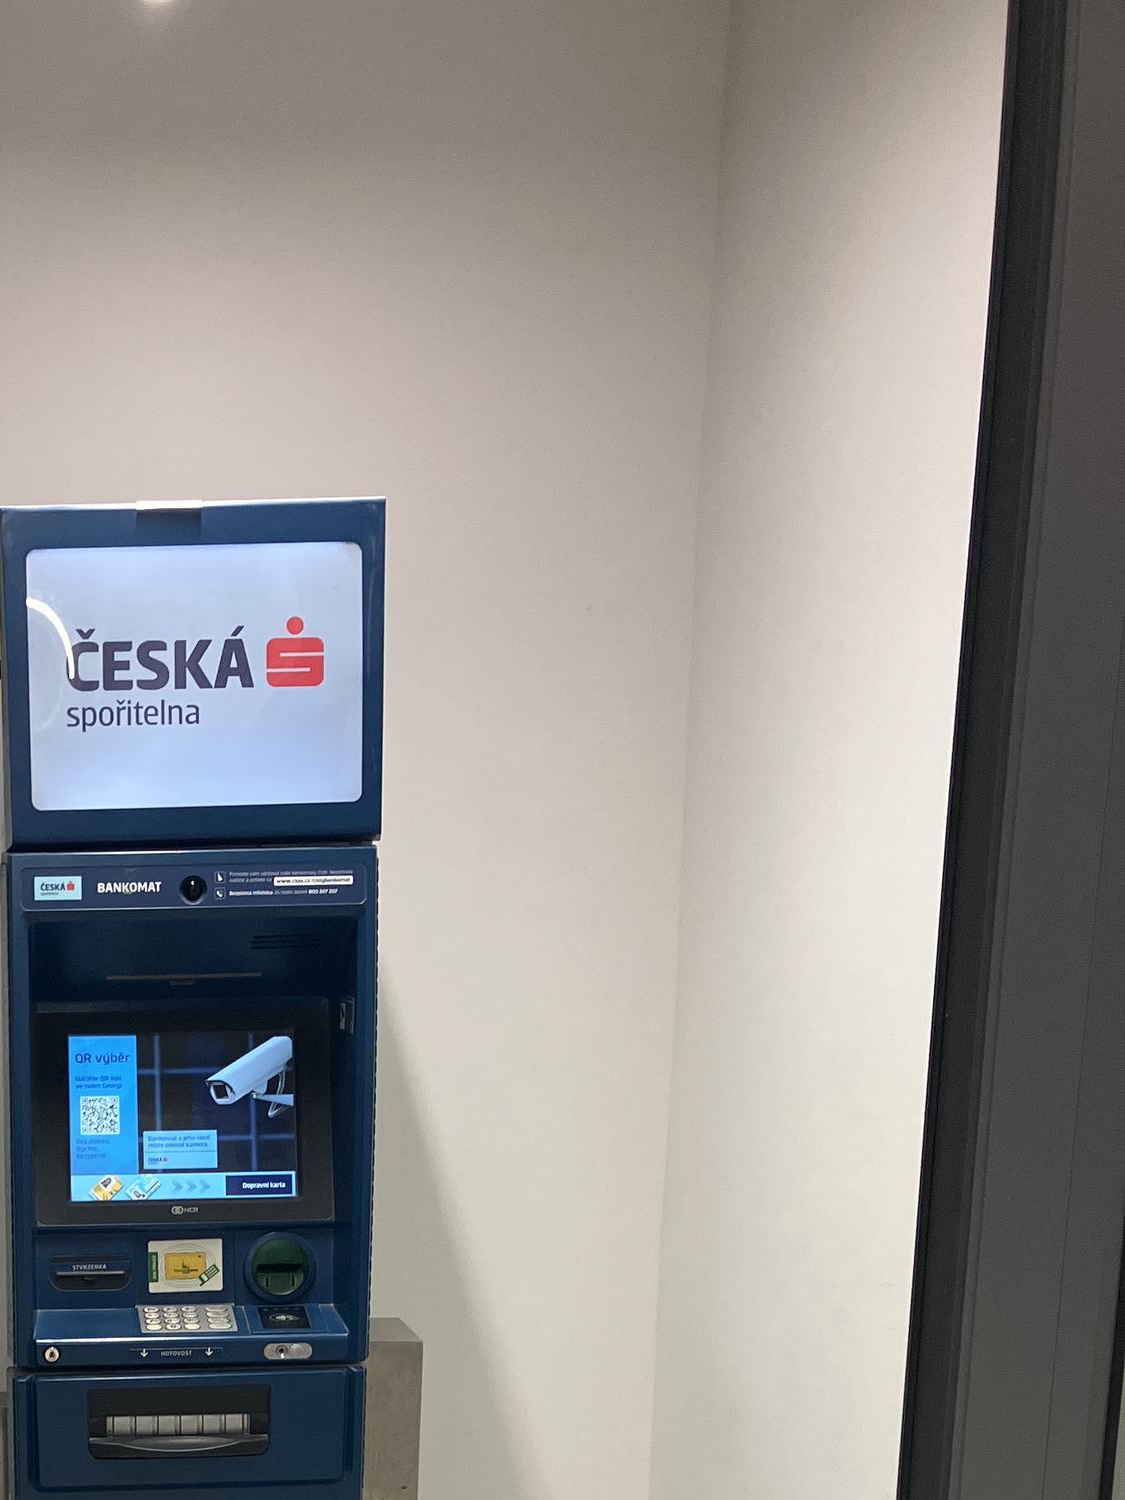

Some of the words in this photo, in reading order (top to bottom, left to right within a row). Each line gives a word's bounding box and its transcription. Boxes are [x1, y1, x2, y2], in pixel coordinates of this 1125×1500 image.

[66, 626, 254, 692] ČESKÁ
[66, 699, 201, 732] spořitelna
[40, 881, 66, 891] ČESKÁ
[97, 881, 162, 893] BANKOMAT
[75, 1053, 91, 1064] QR
[95, 1052, 130, 1066] výběr
[242, 1182, 269, 1190] Dopravní
